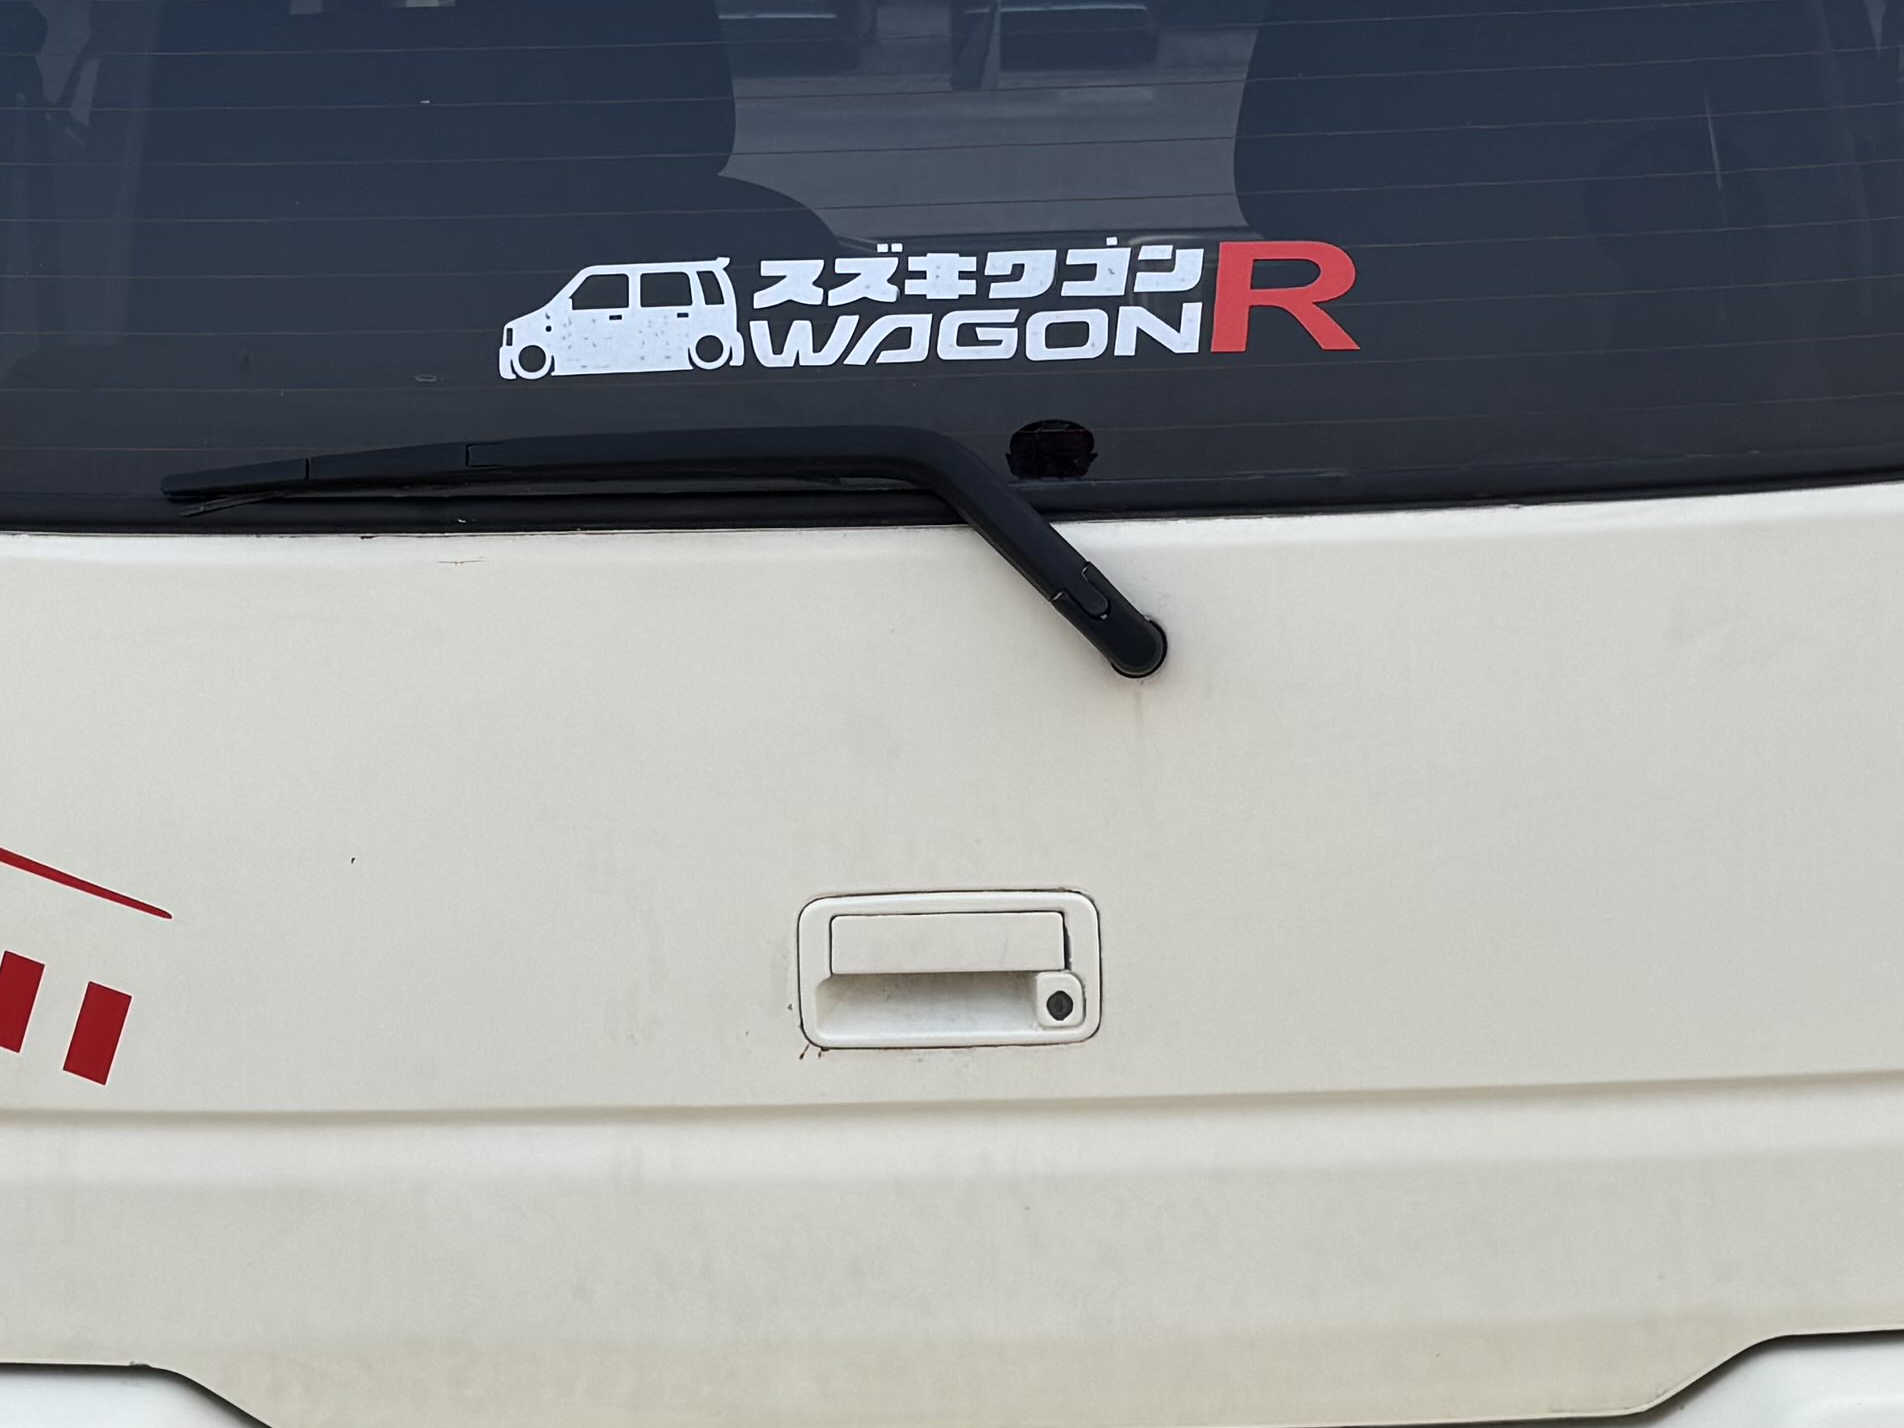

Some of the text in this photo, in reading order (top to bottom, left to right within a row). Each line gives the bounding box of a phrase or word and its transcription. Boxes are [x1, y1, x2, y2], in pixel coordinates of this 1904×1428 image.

[749, 240, 1360, 368] WAGON R
[752, 236, 1204, 308] スズキワゴン
